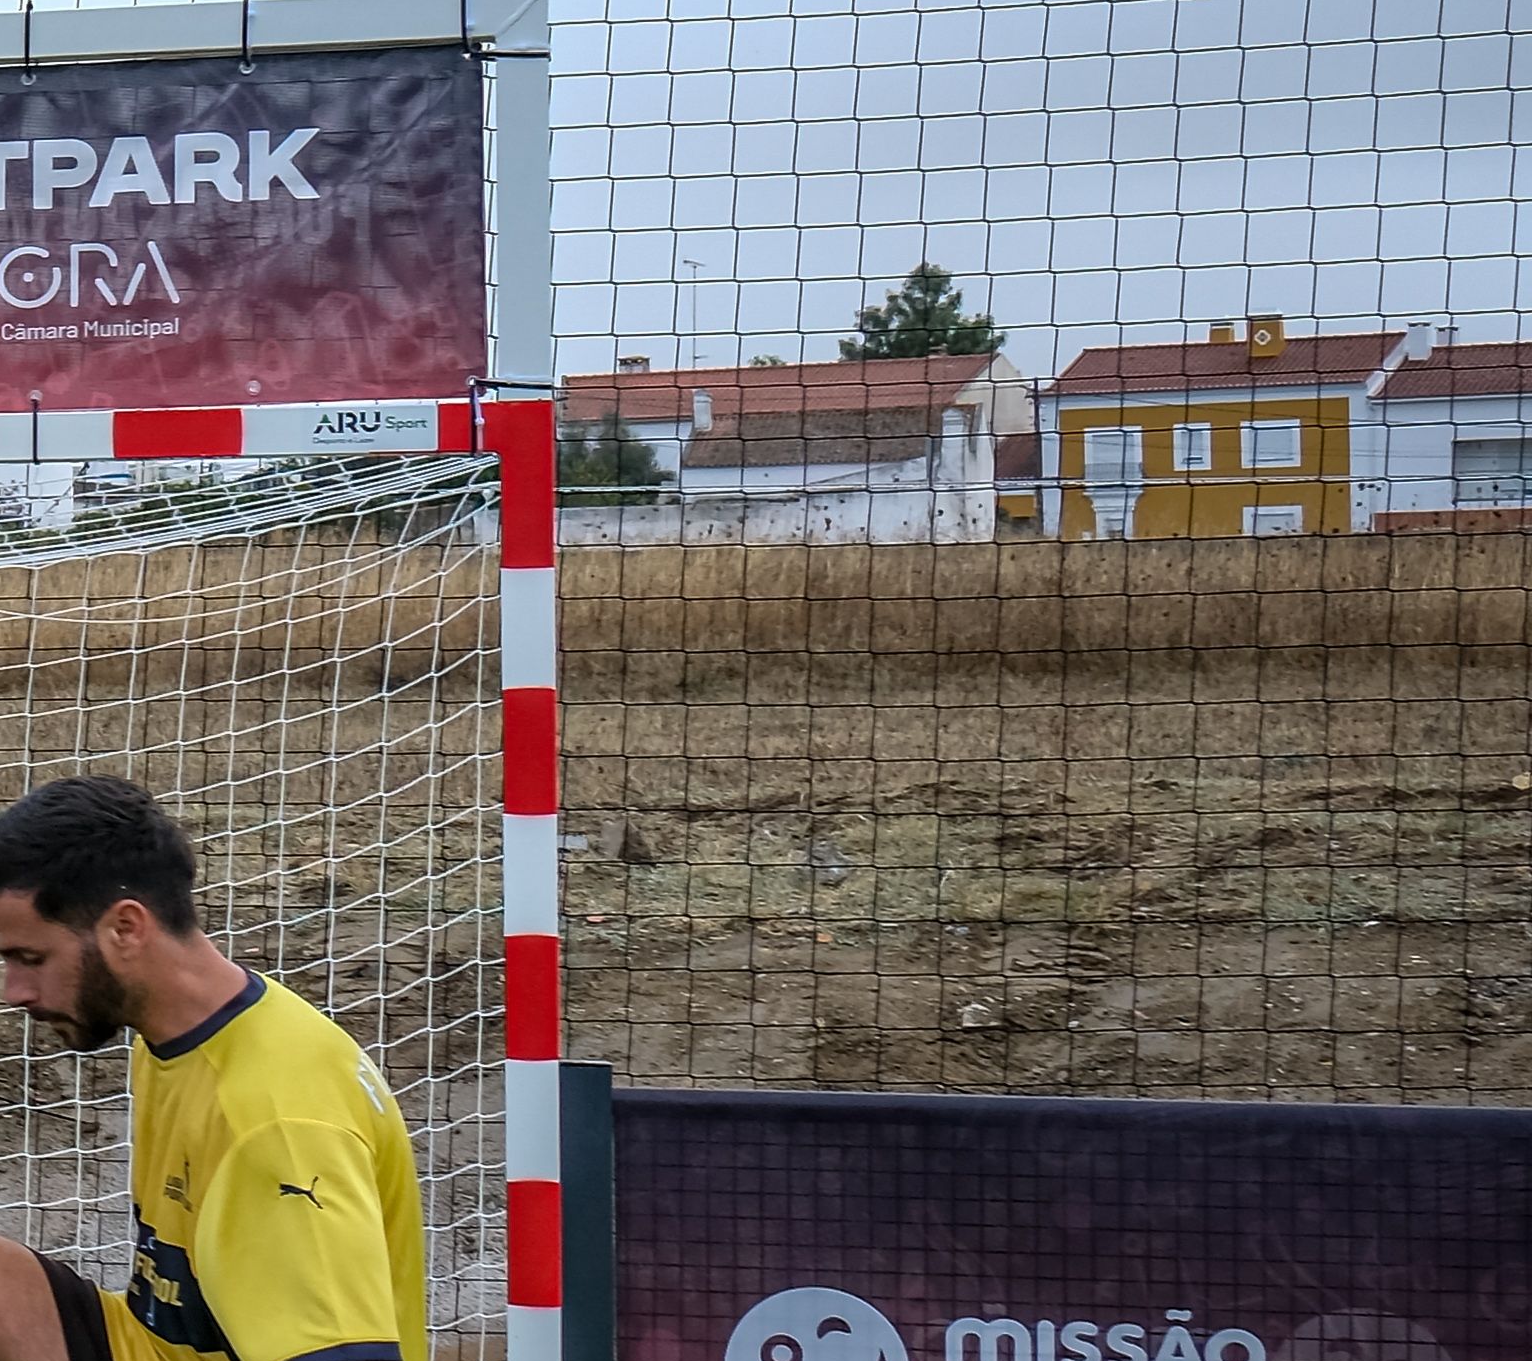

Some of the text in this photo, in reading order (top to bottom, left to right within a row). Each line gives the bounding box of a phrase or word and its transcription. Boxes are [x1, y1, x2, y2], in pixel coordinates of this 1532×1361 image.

[1, 317, 180, 341] Câmara Municipal
[313, 411, 427, 434] ARU Sport
